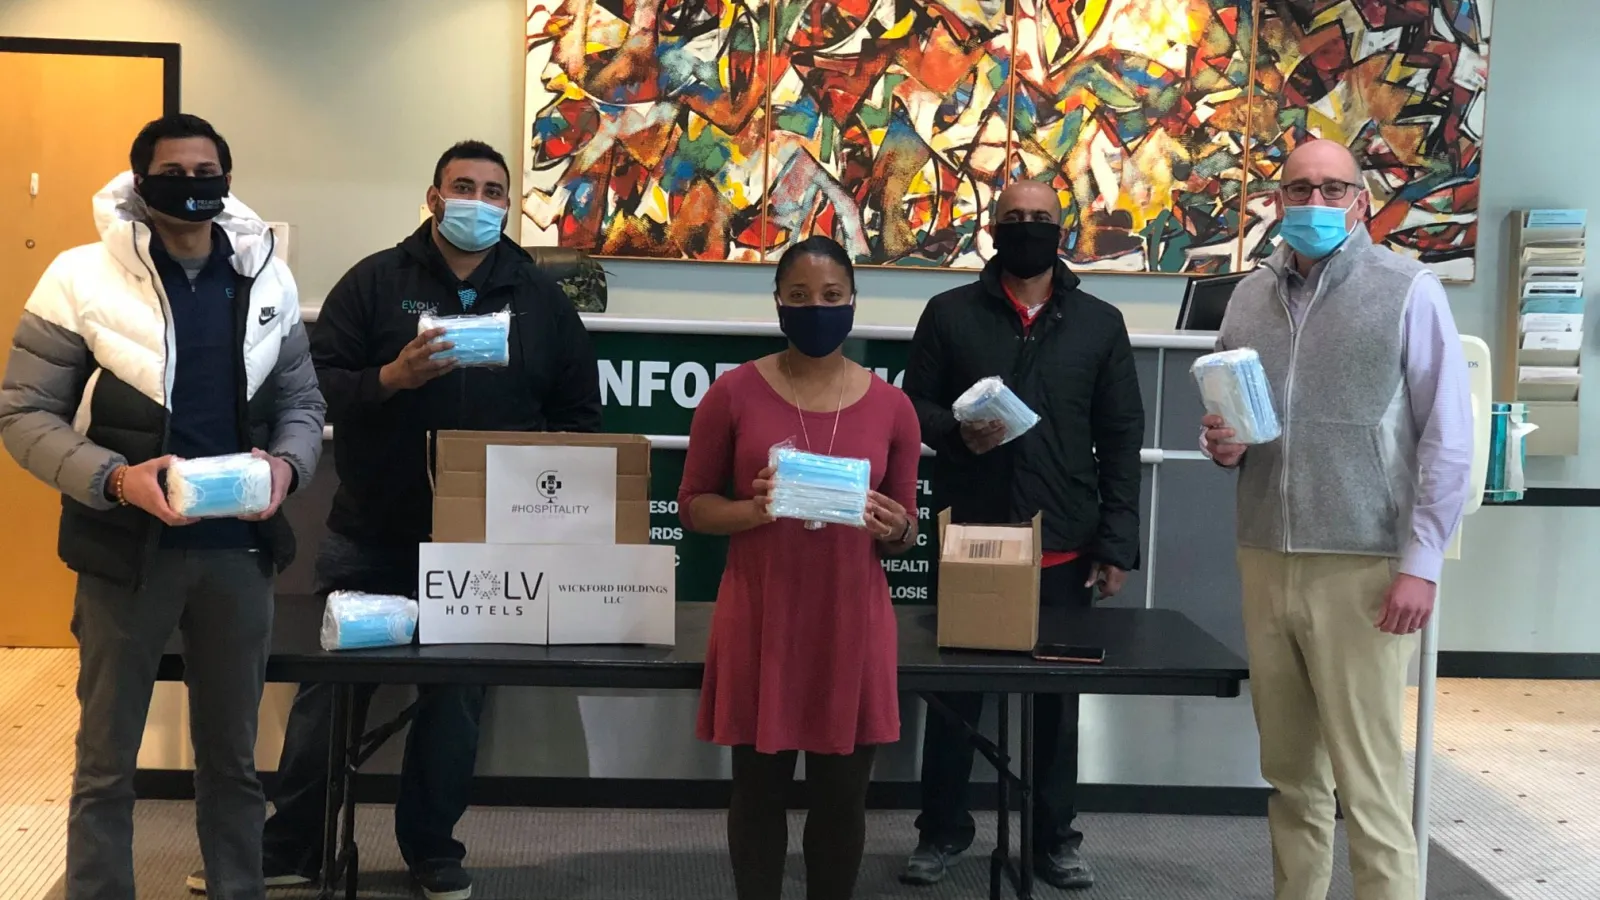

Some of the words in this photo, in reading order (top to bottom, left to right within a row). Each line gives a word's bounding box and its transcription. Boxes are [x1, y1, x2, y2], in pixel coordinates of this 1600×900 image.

[260, 306, 275, 317] NIKE
[511, 504, 590, 514] #HOSPITALITY
[649, 527, 684, 540] RDS
[425, 570, 544, 600] EVOLV
[558, 584, 614, 593] WICKFORD
[616, 584, 669, 594] HOLDINGS
[603, 596, 624, 604] LLC
[445, 605, 524, 616] HOTELS
